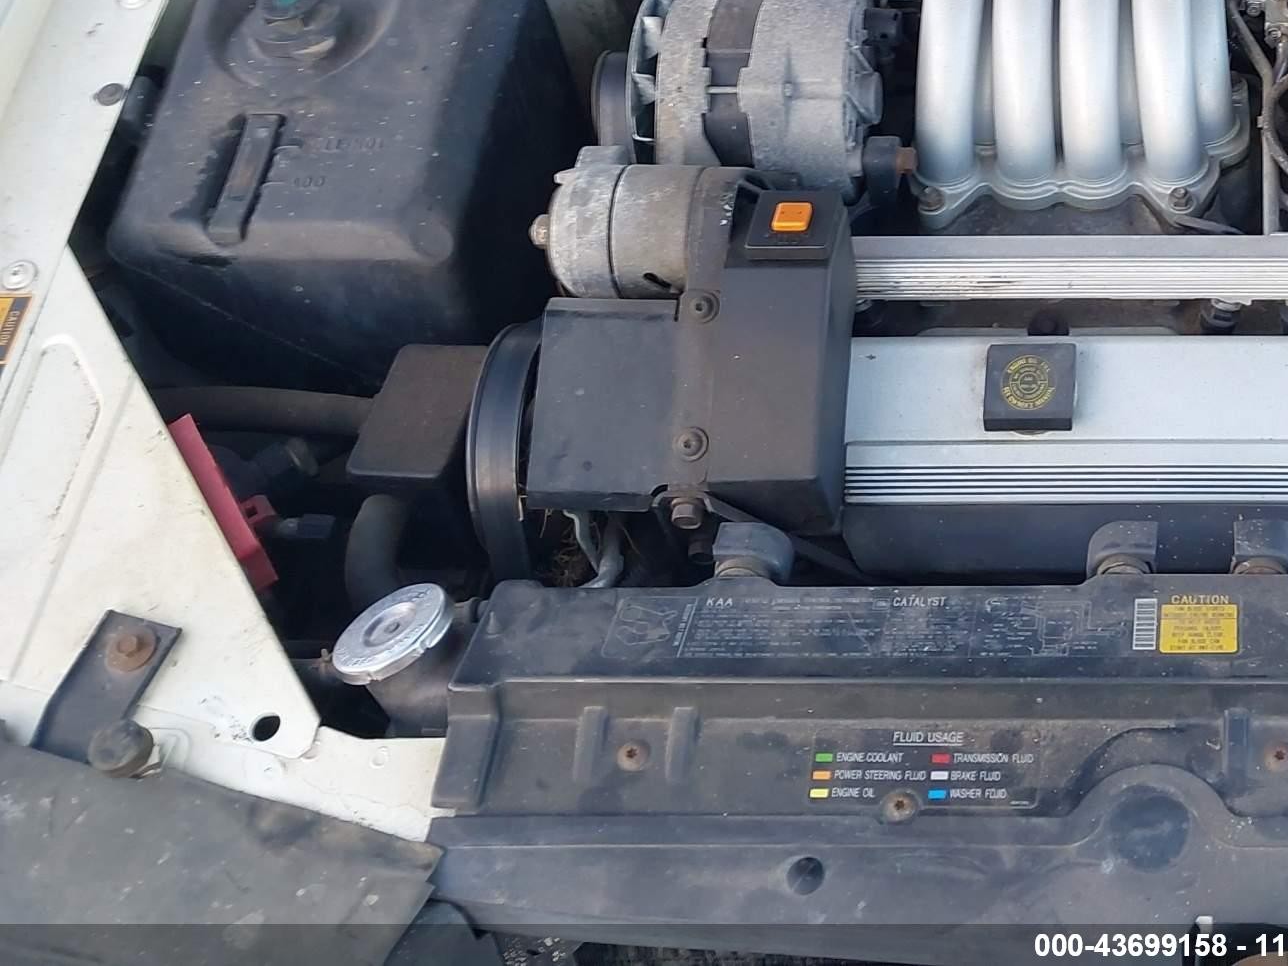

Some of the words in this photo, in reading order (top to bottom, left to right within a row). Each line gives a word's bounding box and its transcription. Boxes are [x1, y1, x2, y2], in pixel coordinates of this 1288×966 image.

[706, 597, 734, 607] KAA
[892, 596, 946, 608] CATALYST
[1171, 594, 1229, 605] CAUTION
[893, 731, 925, 743] FLUID
[927, 731, 964, 743] USAGE
[836, 753, 865, 763] ENGINE
[865, 753, 904, 763] COOLANT
[953, 753, 1009, 764] TRANSMISSION
[1012, 754, 1034, 764] FLUID
[834, 769, 862, 780] POWER
[864, 770, 902, 781] STEERING
[904, 770, 927, 781] FLUID
[950, 770, 977, 781] BRAKE
[980, 770, 1002, 781] FLUID
[831, 787, 860, 798] ENGINE
[862, 788, 876, 798] OIL
[950, 788, 982, 799] WASHER
[984, 788, 1008, 799] FLUID
